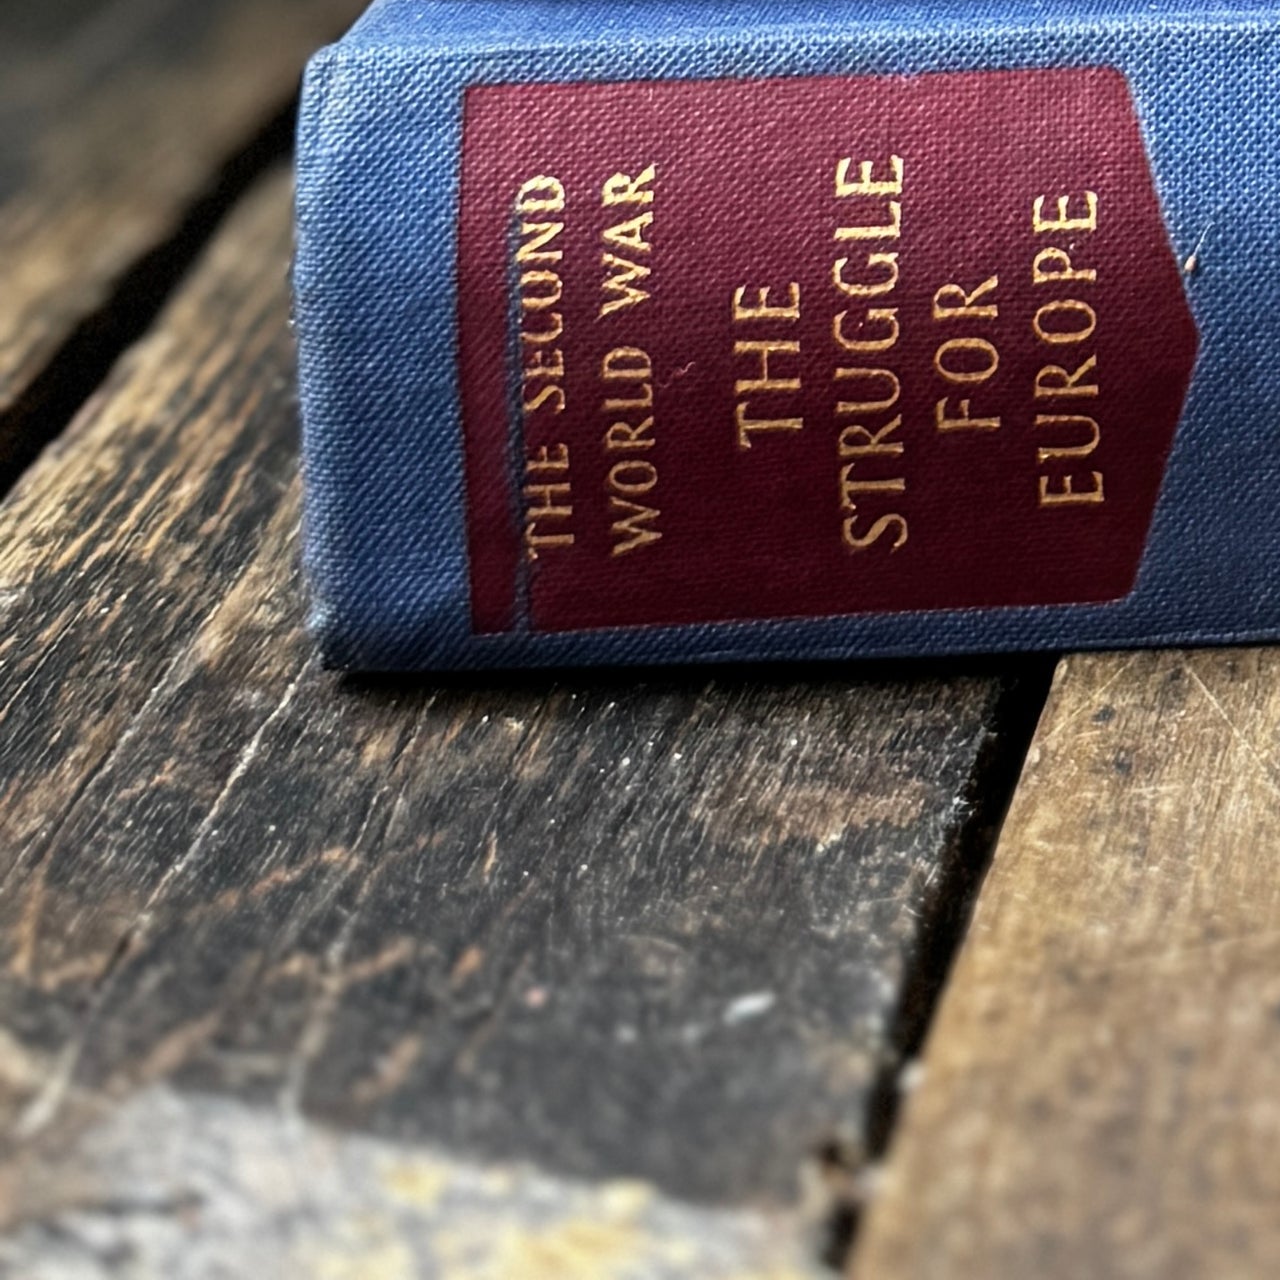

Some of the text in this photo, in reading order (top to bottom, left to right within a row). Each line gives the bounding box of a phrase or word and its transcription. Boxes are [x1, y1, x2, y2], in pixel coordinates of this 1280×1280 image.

[515, 174, 575, 560] THE SECOND
[598, 163, 663, 557] WORLD WAR
[732, 282, 803, 450] THE
[832, 154, 909, 553] STRUGGLE
[932, 274, 1001, 433] FOR
[1032, 190, 1105, 507] EUROPE
